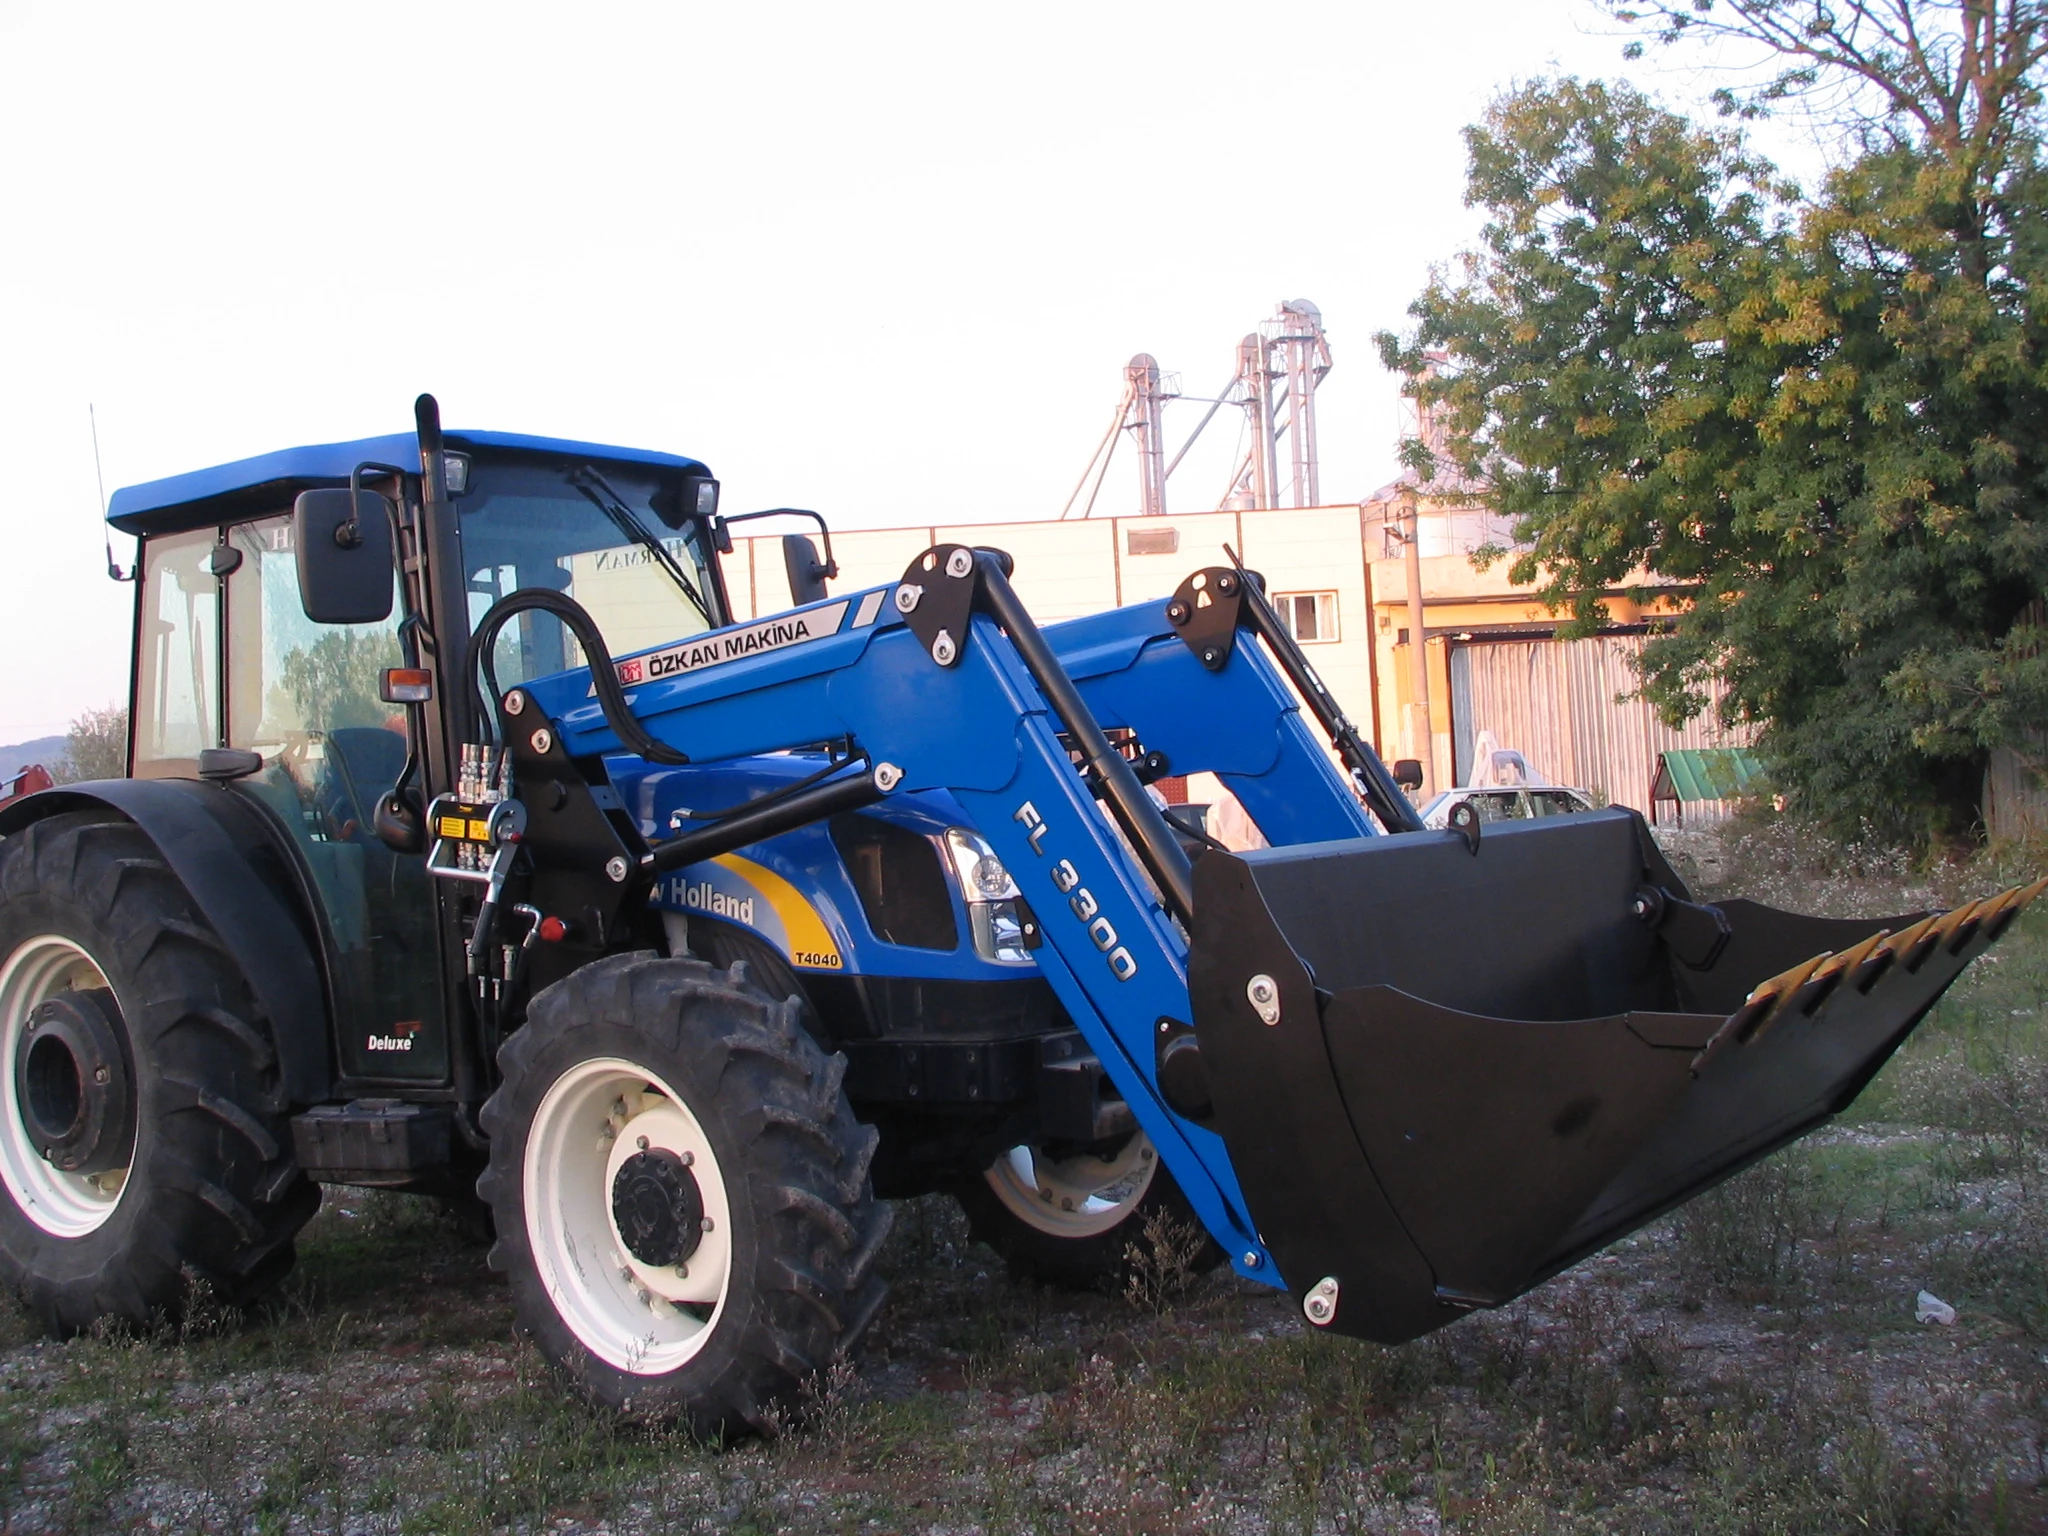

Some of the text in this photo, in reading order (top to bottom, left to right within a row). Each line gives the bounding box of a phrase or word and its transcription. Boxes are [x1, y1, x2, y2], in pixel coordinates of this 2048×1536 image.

[649, 643, 719, 677] ÖZKAN
[725, 620, 810, 658] MAKİNA
[671, 877, 754, 925] Holland
[1012, 800, 1138, 983] FL 3300
[795, 952, 838, 967] T4040
[367, 1034, 412, 1051] Deluxe
